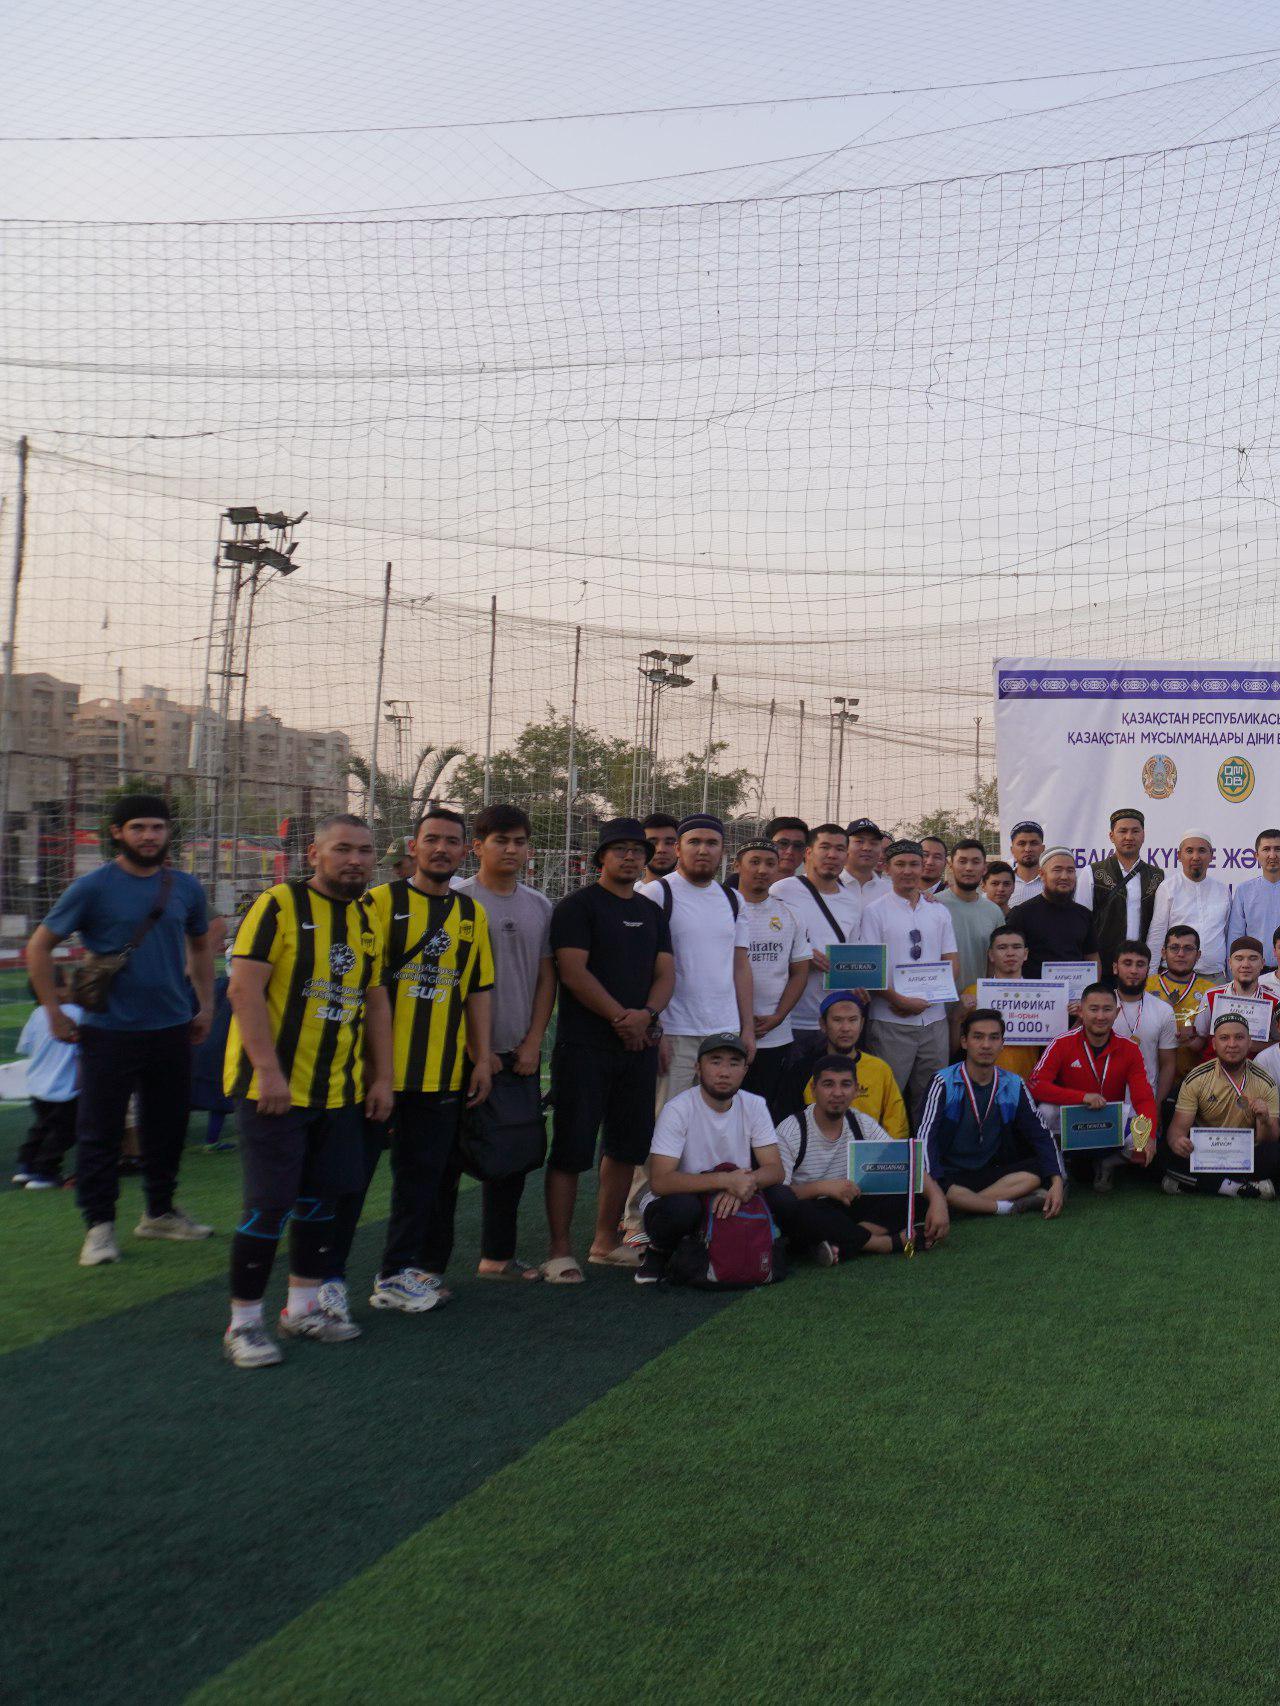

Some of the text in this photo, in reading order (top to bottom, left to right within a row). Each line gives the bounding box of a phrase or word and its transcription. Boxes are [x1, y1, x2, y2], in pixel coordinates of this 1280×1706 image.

[1122, 712, 1190, 726] ҚАЗАҚСТАН
[1067, 732, 1135, 746] ҚАЗАҚСТАН
[1140, 732, 1244, 745] МҰСЫЛМАНДАРЫ
[1246, 733, 1274, 746] ДІНИ
[749, 941, 784, 953] irates
[752, 952, 778, 962] BETTER
[990, 1000, 1056, 1010] СЕРТИФИКАТ
[1018, 1021, 1043, 1032] 000
